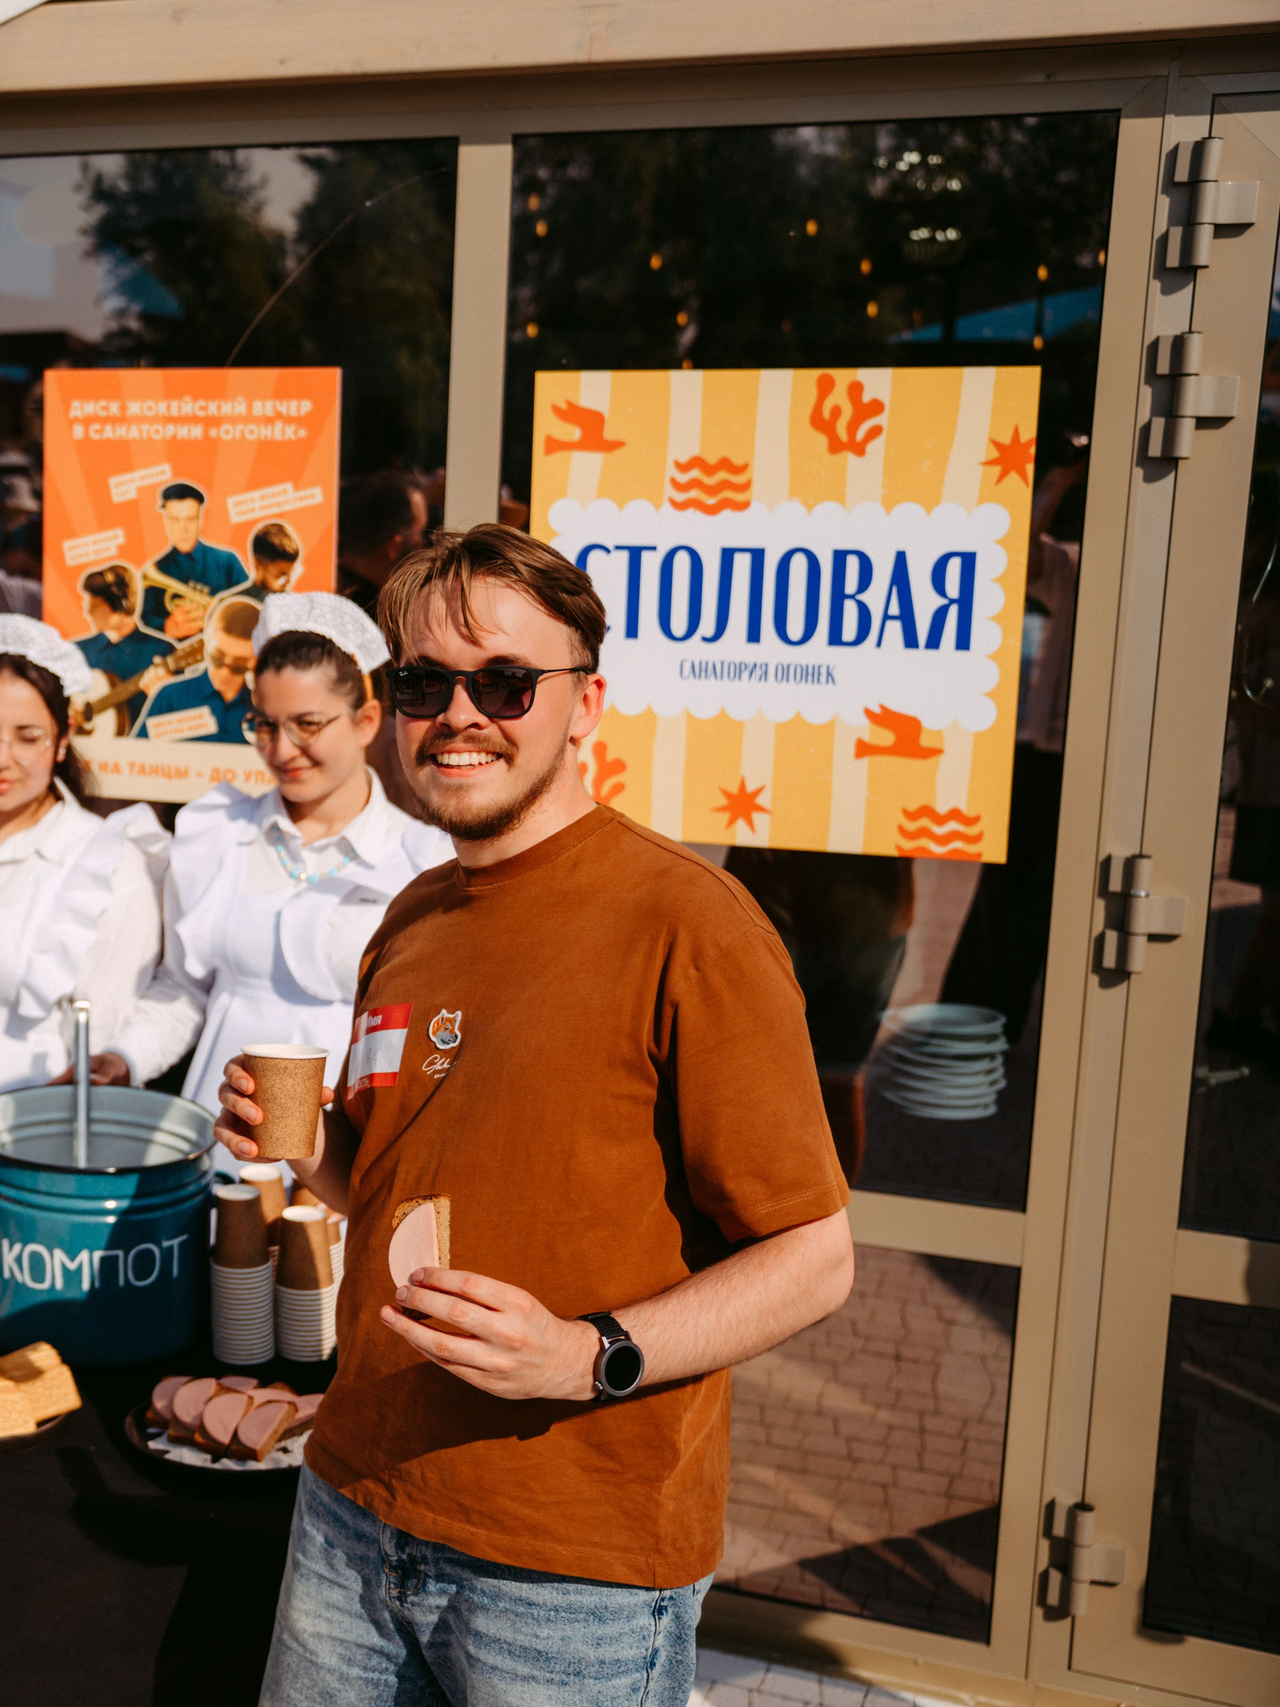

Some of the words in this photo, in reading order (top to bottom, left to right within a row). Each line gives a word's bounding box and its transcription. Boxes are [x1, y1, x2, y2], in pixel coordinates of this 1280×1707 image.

[69, 399, 121, 418] ДИСК
[126, 396, 247, 417] ЖОКЕЙСКИЙ
[252, 400, 313, 416] ВЕЧЕР
[73, 423, 85, 440] В
[89, 423, 204, 440] САНАТОРИИ
[208, 421, 307, 441] «ОГОНЁК»
[679, 658, 769, 683] САНАТОРИЯ
[774, 662, 837, 686] ОГОНЕК
[98, 761, 122, 775] НА
[127, 762, 190, 781] ТАНЦЫ
[209, 767, 237, 784] ДО
[1, 1233, 189, 1292] КОМПОТ
